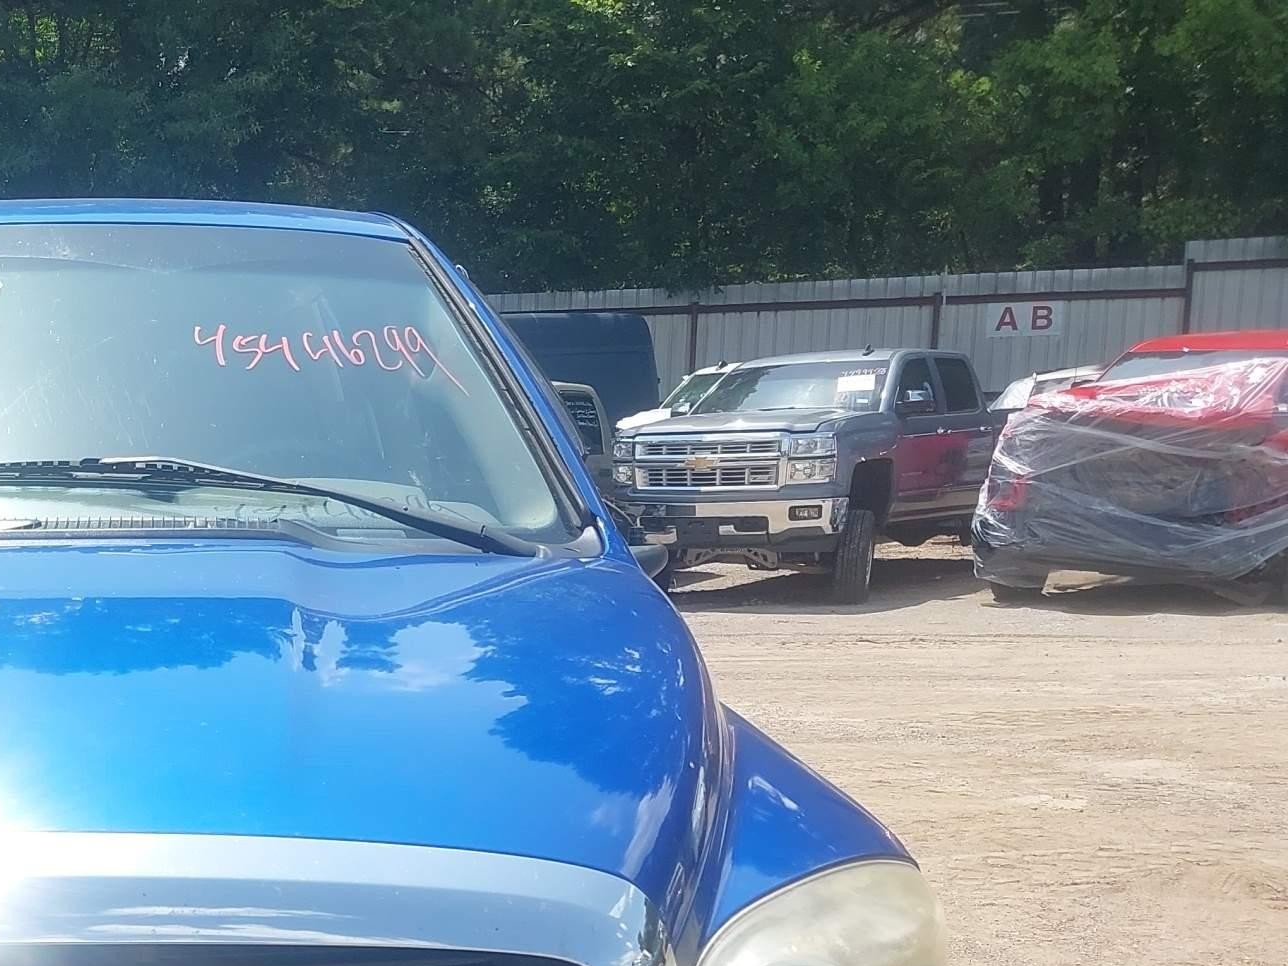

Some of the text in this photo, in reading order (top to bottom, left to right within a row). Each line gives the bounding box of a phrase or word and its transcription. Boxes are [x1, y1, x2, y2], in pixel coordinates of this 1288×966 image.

[994, 305, 1053, 332] A B
[193, 323, 470, 397] 45446299
